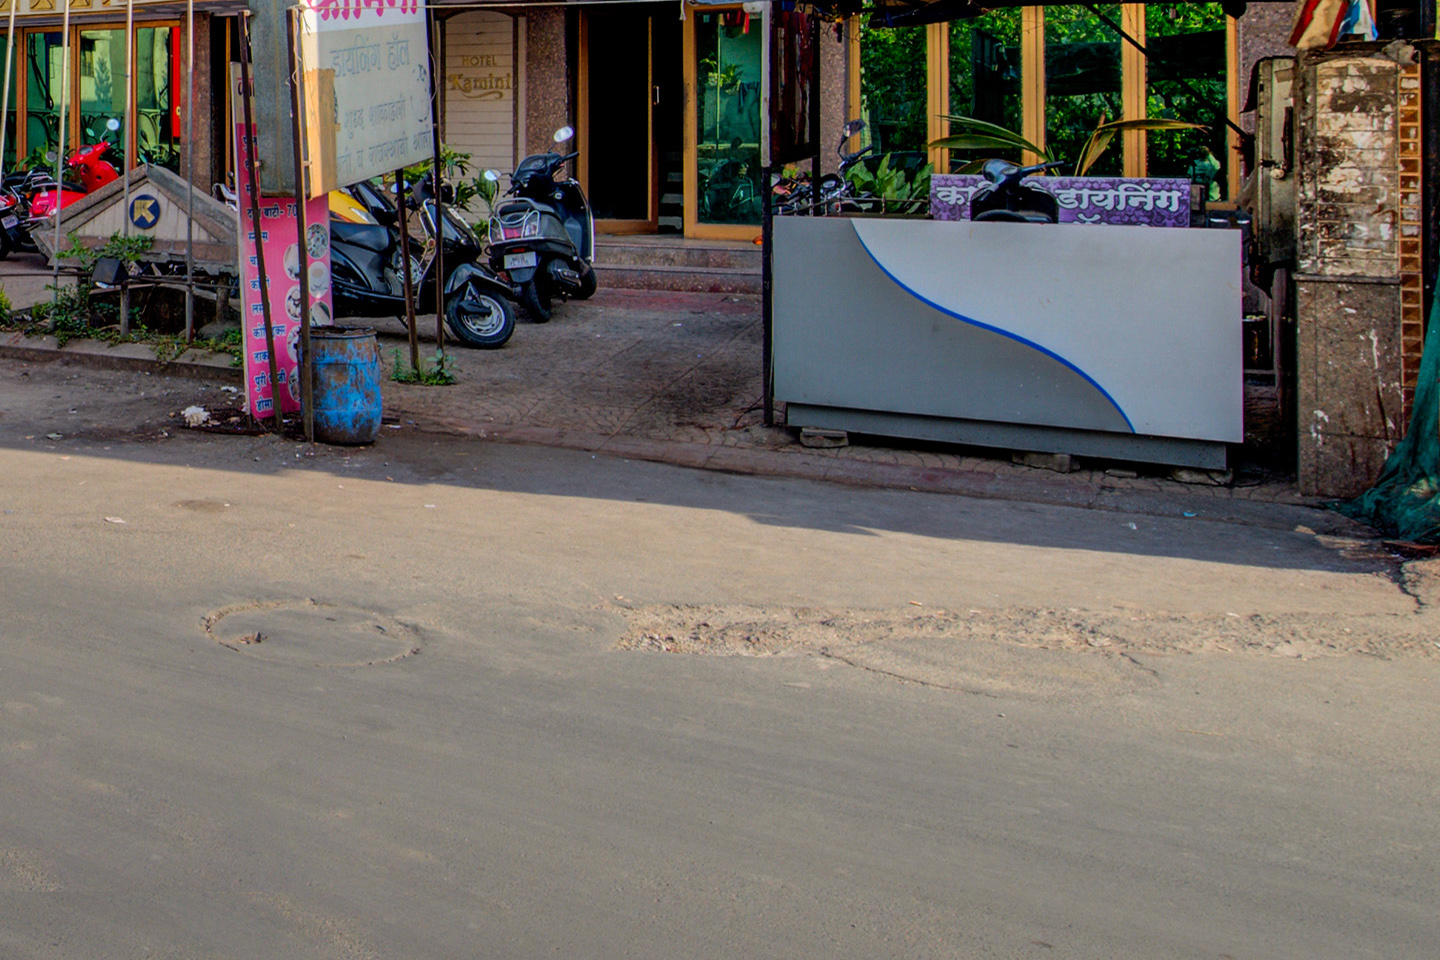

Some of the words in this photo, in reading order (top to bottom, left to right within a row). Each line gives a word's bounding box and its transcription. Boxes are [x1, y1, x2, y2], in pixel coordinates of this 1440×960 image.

[462, 55, 497, 67] HOTEL
[448, 73, 513, 92] Kamini
[1055, 183, 1182, 213] डायनिंग
